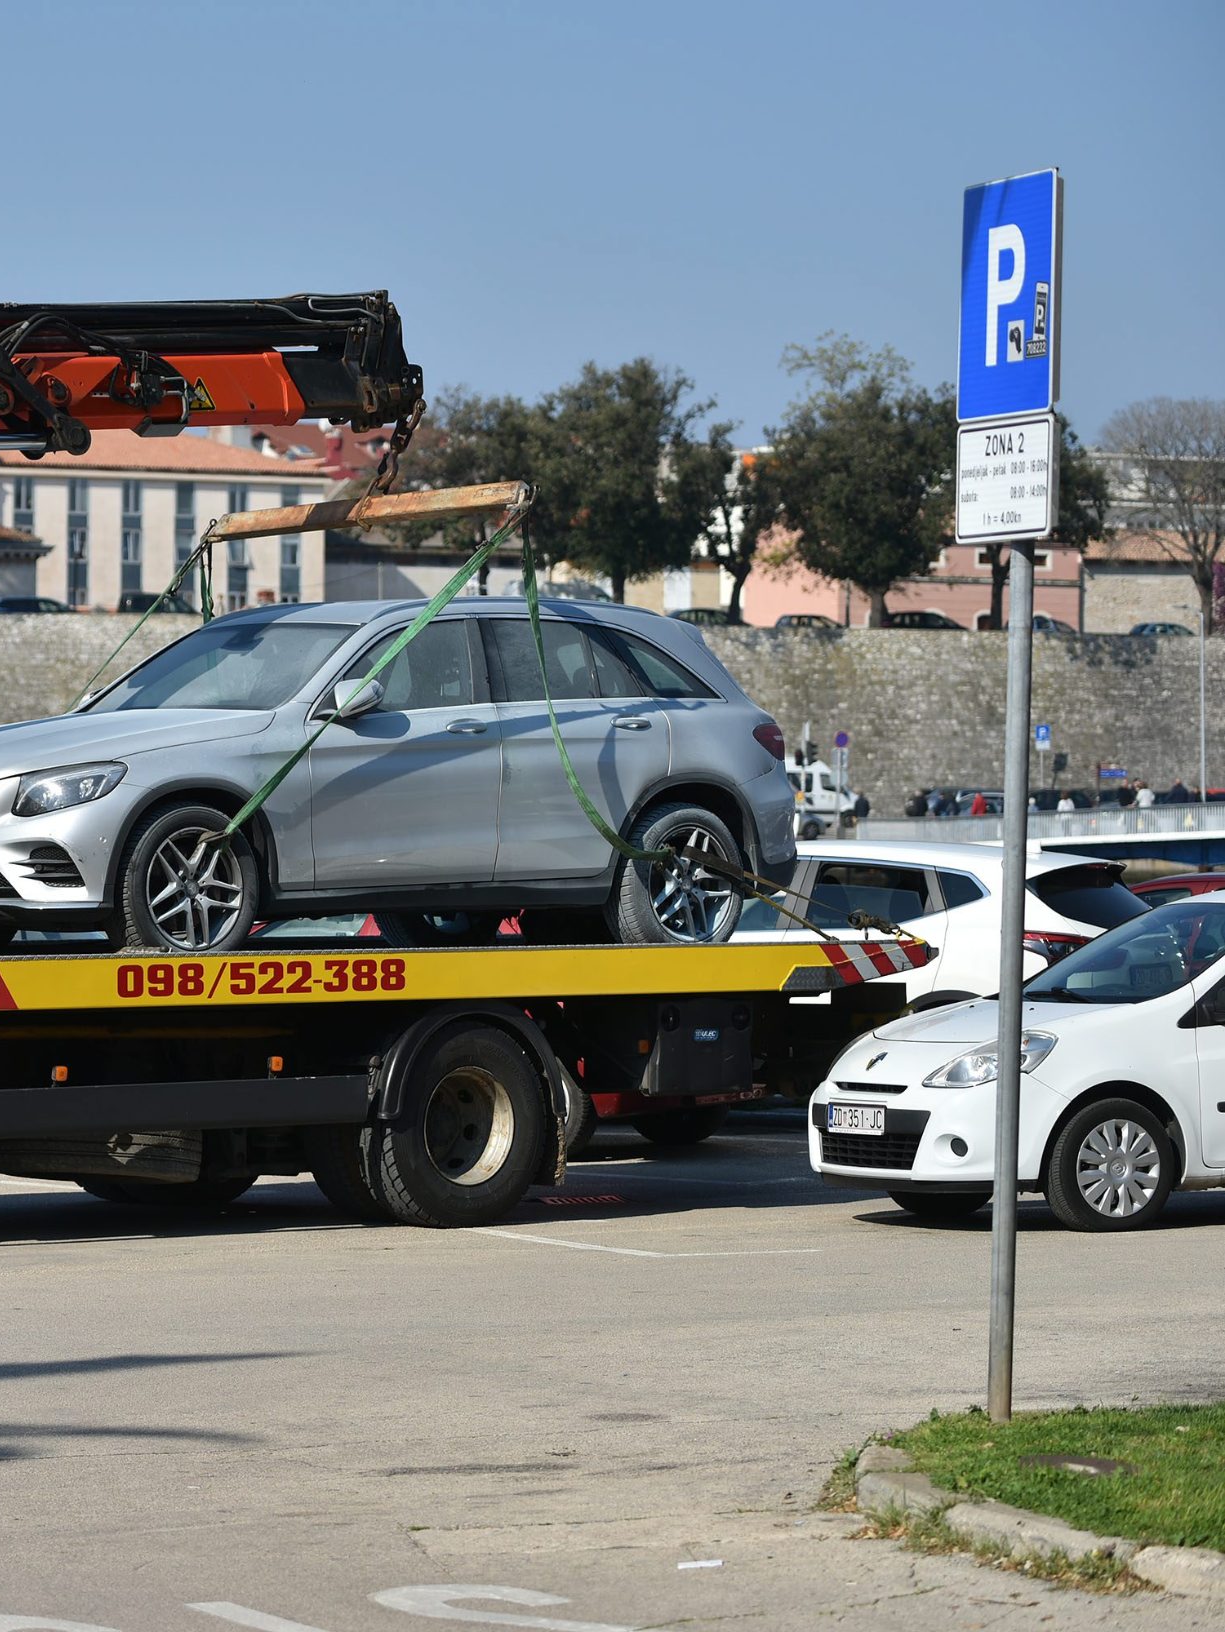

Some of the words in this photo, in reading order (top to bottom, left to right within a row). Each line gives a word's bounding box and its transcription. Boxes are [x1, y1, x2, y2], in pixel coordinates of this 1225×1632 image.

[985, 223, 1025, 367] P
[985, 433, 1013, 456] ZONA
[1018, 432, 1024, 453] 2
[117, 958, 406, 998] 098/522-388
[834, 1108, 842, 1126] ZD
